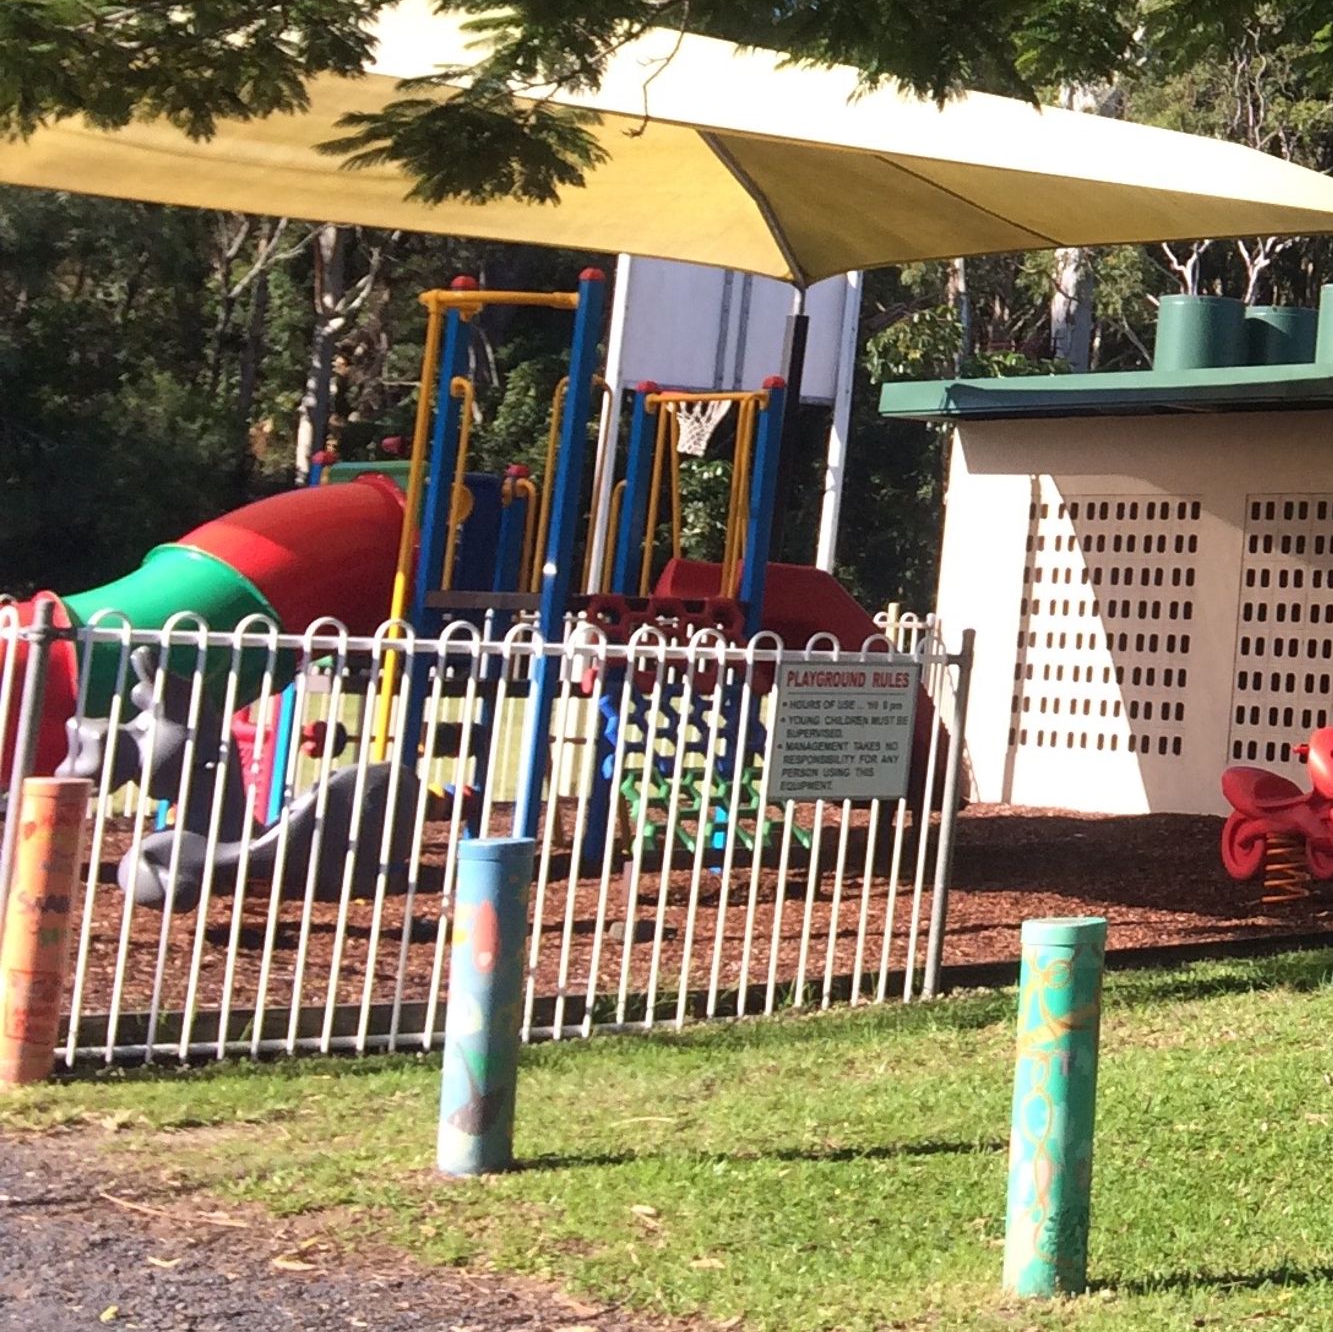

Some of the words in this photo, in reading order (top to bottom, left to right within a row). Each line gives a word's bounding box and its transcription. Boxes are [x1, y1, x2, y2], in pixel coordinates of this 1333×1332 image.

[786, 671, 866, 687] PLAYGROUND
[872, 672, 910, 688] RULES
[789, 700, 821, 709] HOURS
[823, 700, 835, 709] OF
[837, 700, 855, 709] USE
[889, 703, 902, 711] pm
[789, 716, 820, 725] YOUNG
[824, 716, 868, 725] CHILDREN
[871, 716, 895, 725] MUST
[896, 716, 909, 725] BE
[785, 741, 849, 751] MANAGEMENT
[853, 741, 880, 751] TAKES
[885, 742, 898, 751] NO
[783, 754, 856, 764] RESPONSIBILITY
[859, 754, 878, 764] FOR
[881, 755, 899, 764] ANY
[781, 767, 818, 777] PERSON
[822, 767, 850, 777] USING
[855, 767, 875, 776] THIS
